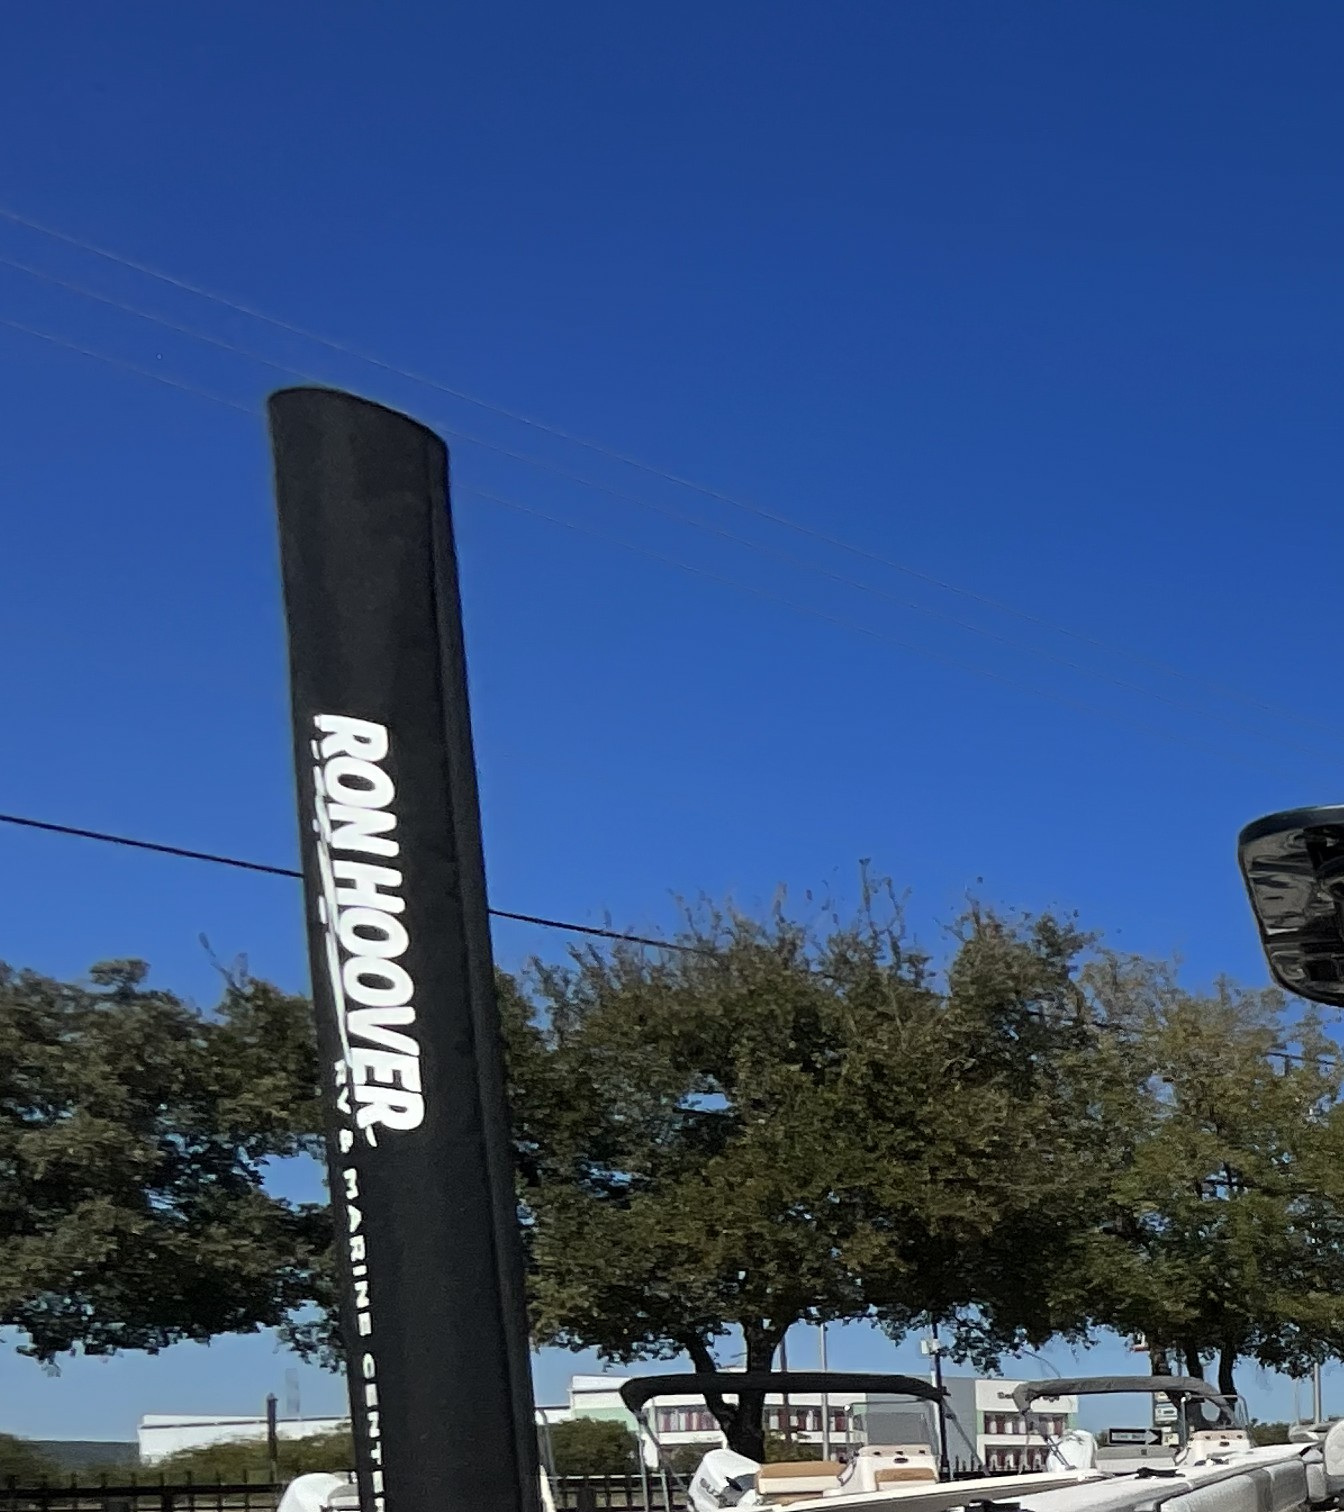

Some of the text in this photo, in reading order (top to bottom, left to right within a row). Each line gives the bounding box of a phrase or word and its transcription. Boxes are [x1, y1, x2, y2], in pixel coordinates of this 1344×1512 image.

[314, 714, 425, 1131] RON HOOVER
[343, 1168, 372, 1337] MARINE
